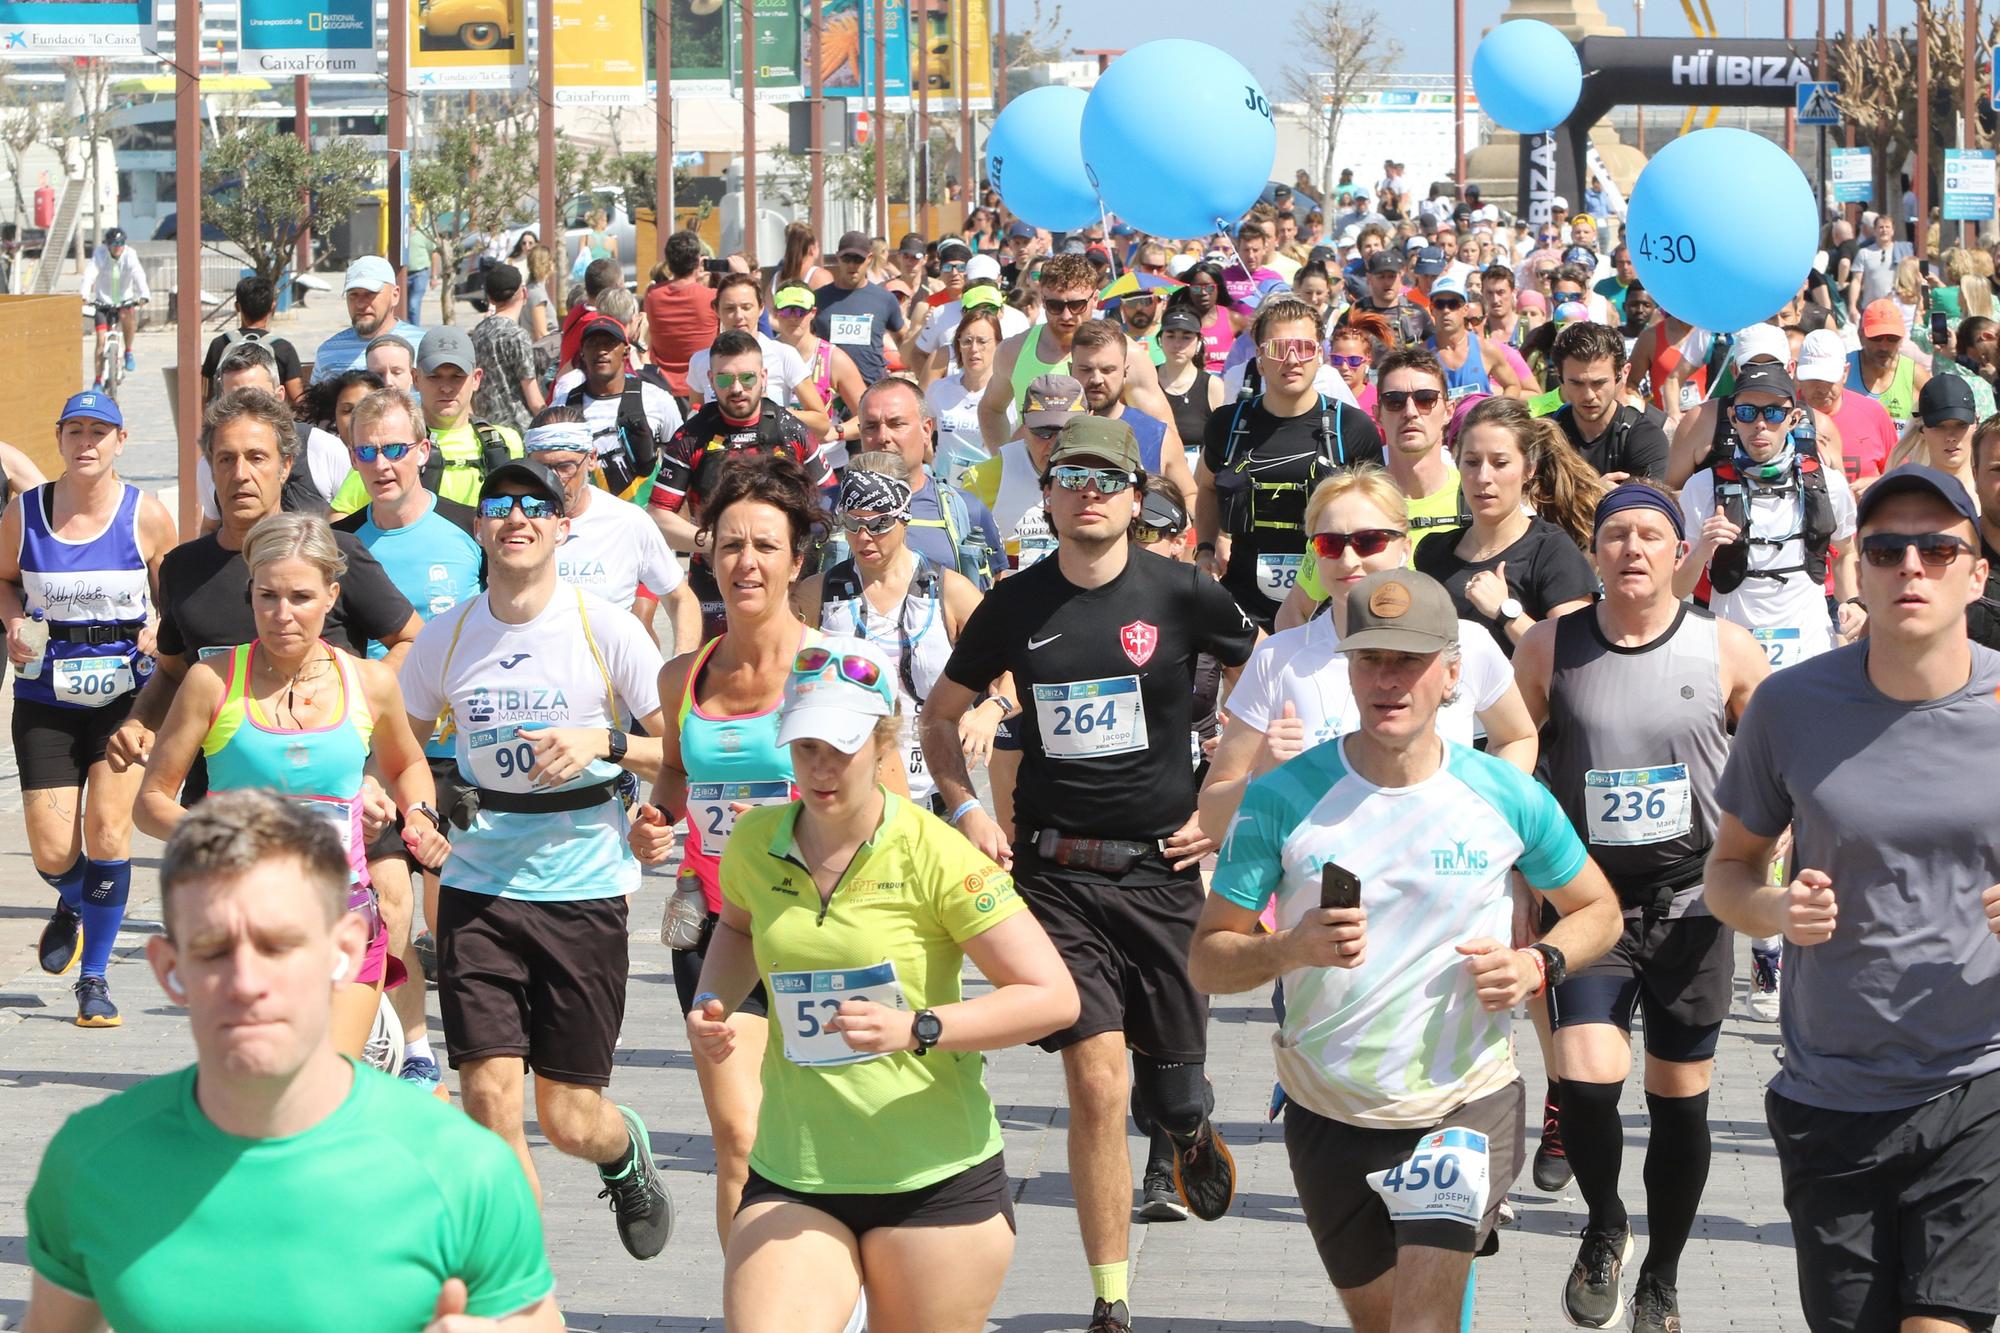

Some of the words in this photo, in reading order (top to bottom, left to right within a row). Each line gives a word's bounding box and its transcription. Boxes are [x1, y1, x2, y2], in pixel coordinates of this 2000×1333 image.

[32, 32, 85, 45] Fundació
[259, 54, 356, 71] CaixaForum
[1716, 56, 1813, 87] IBIZA
[556, 90, 630, 103] CaixaForum
[1640, 232, 1696, 264] 4:30
[837, 323, 861, 336] 508
[67, 673, 115, 695] 306
[498, 688, 569, 711] IBIZA
[498, 711, 569, 721] MARATHON
[1053, 700, 1117, 736] 264
[701, 787, 719, 796] IBIZA
[1601, 788, 1666, 822] 236
[1656, 819, 1677, 829] Mark
[1382, 1153, 1460, 1193] 450
[1433, 1192, 1471, 1204] JOSEPH
